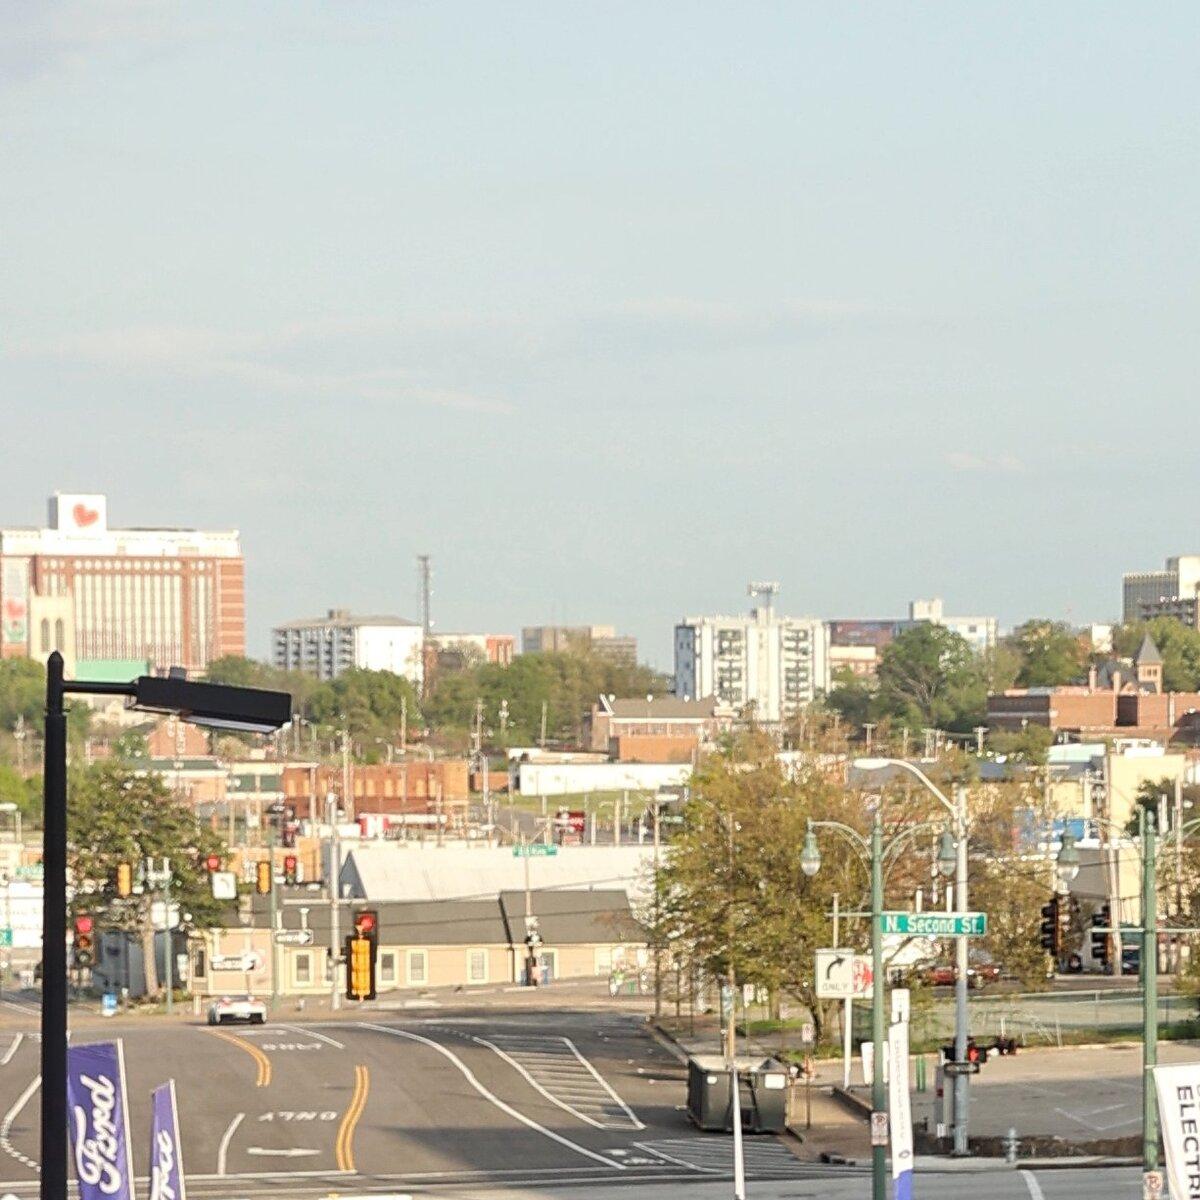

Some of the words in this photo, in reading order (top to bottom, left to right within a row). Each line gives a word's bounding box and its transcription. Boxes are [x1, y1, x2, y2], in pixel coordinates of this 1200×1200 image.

[886, 915, 902, 933] N.
[907, 915, 956, 933] Second
[960, 916, 982, 934] St.
[74, 1074, 122, 1195] Ford
